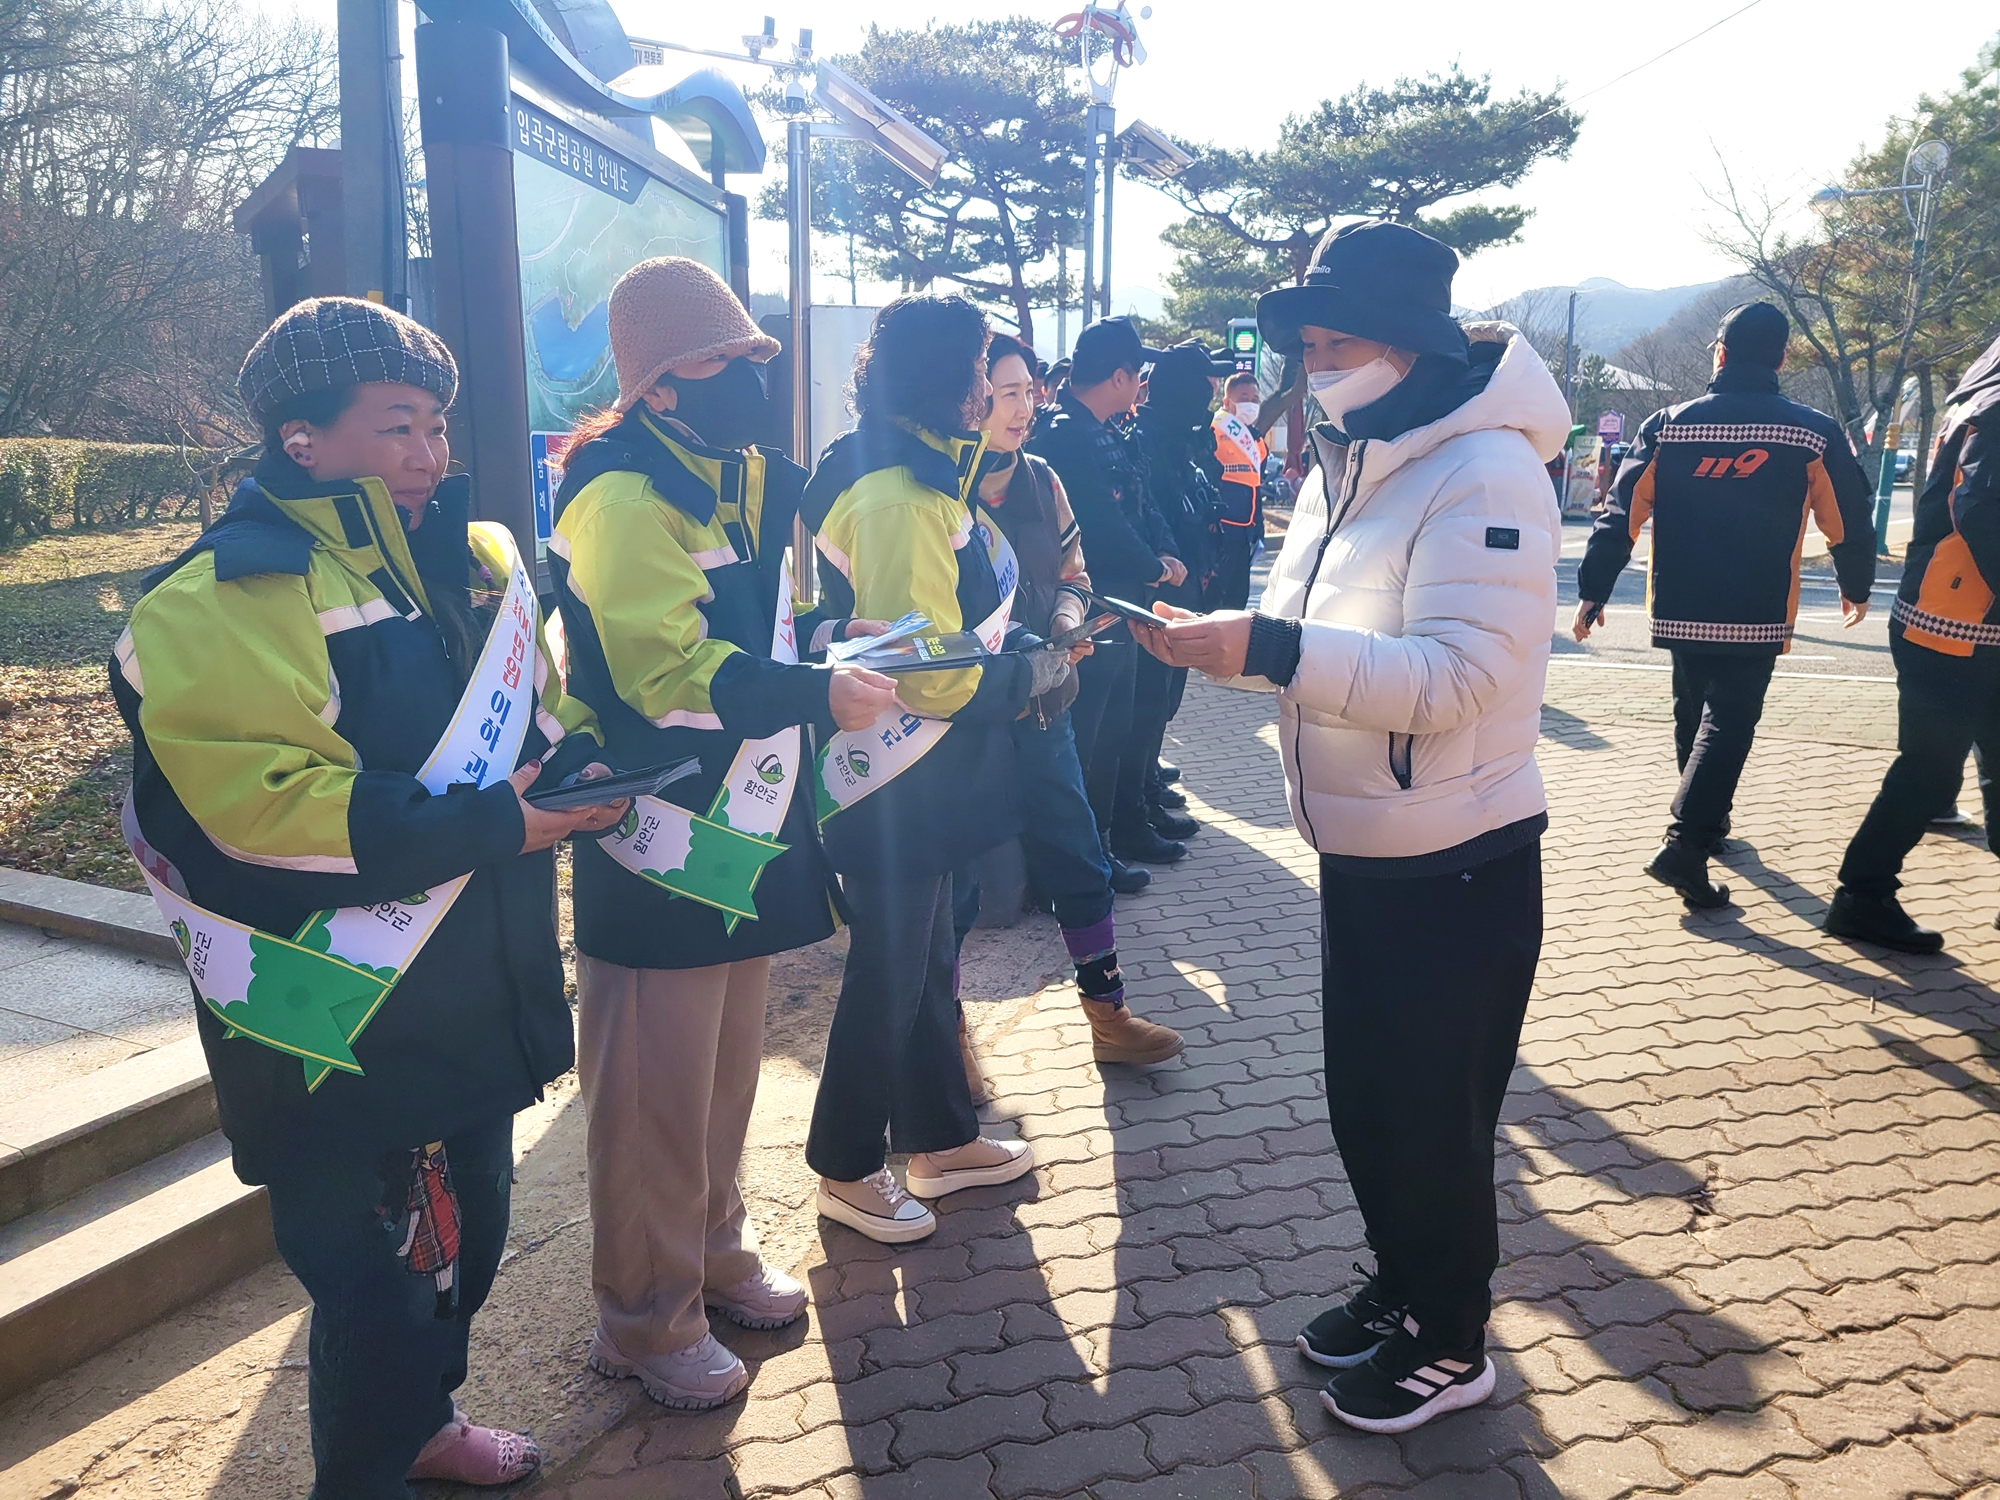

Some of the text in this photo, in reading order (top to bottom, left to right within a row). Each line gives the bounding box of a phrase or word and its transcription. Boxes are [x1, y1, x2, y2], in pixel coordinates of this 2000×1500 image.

[517, 109, 629, 193] 입곡군립공원 안내도
[1692, 448, 1769, 478] 119
[480, 690, 512, 753] 이하
[834, 753, 858, 787] 함안군
[743, 778, 779, 805] 함안군
[632, 814, 661, 855] 함안군
[193, 931, 212, 980] 함안군
